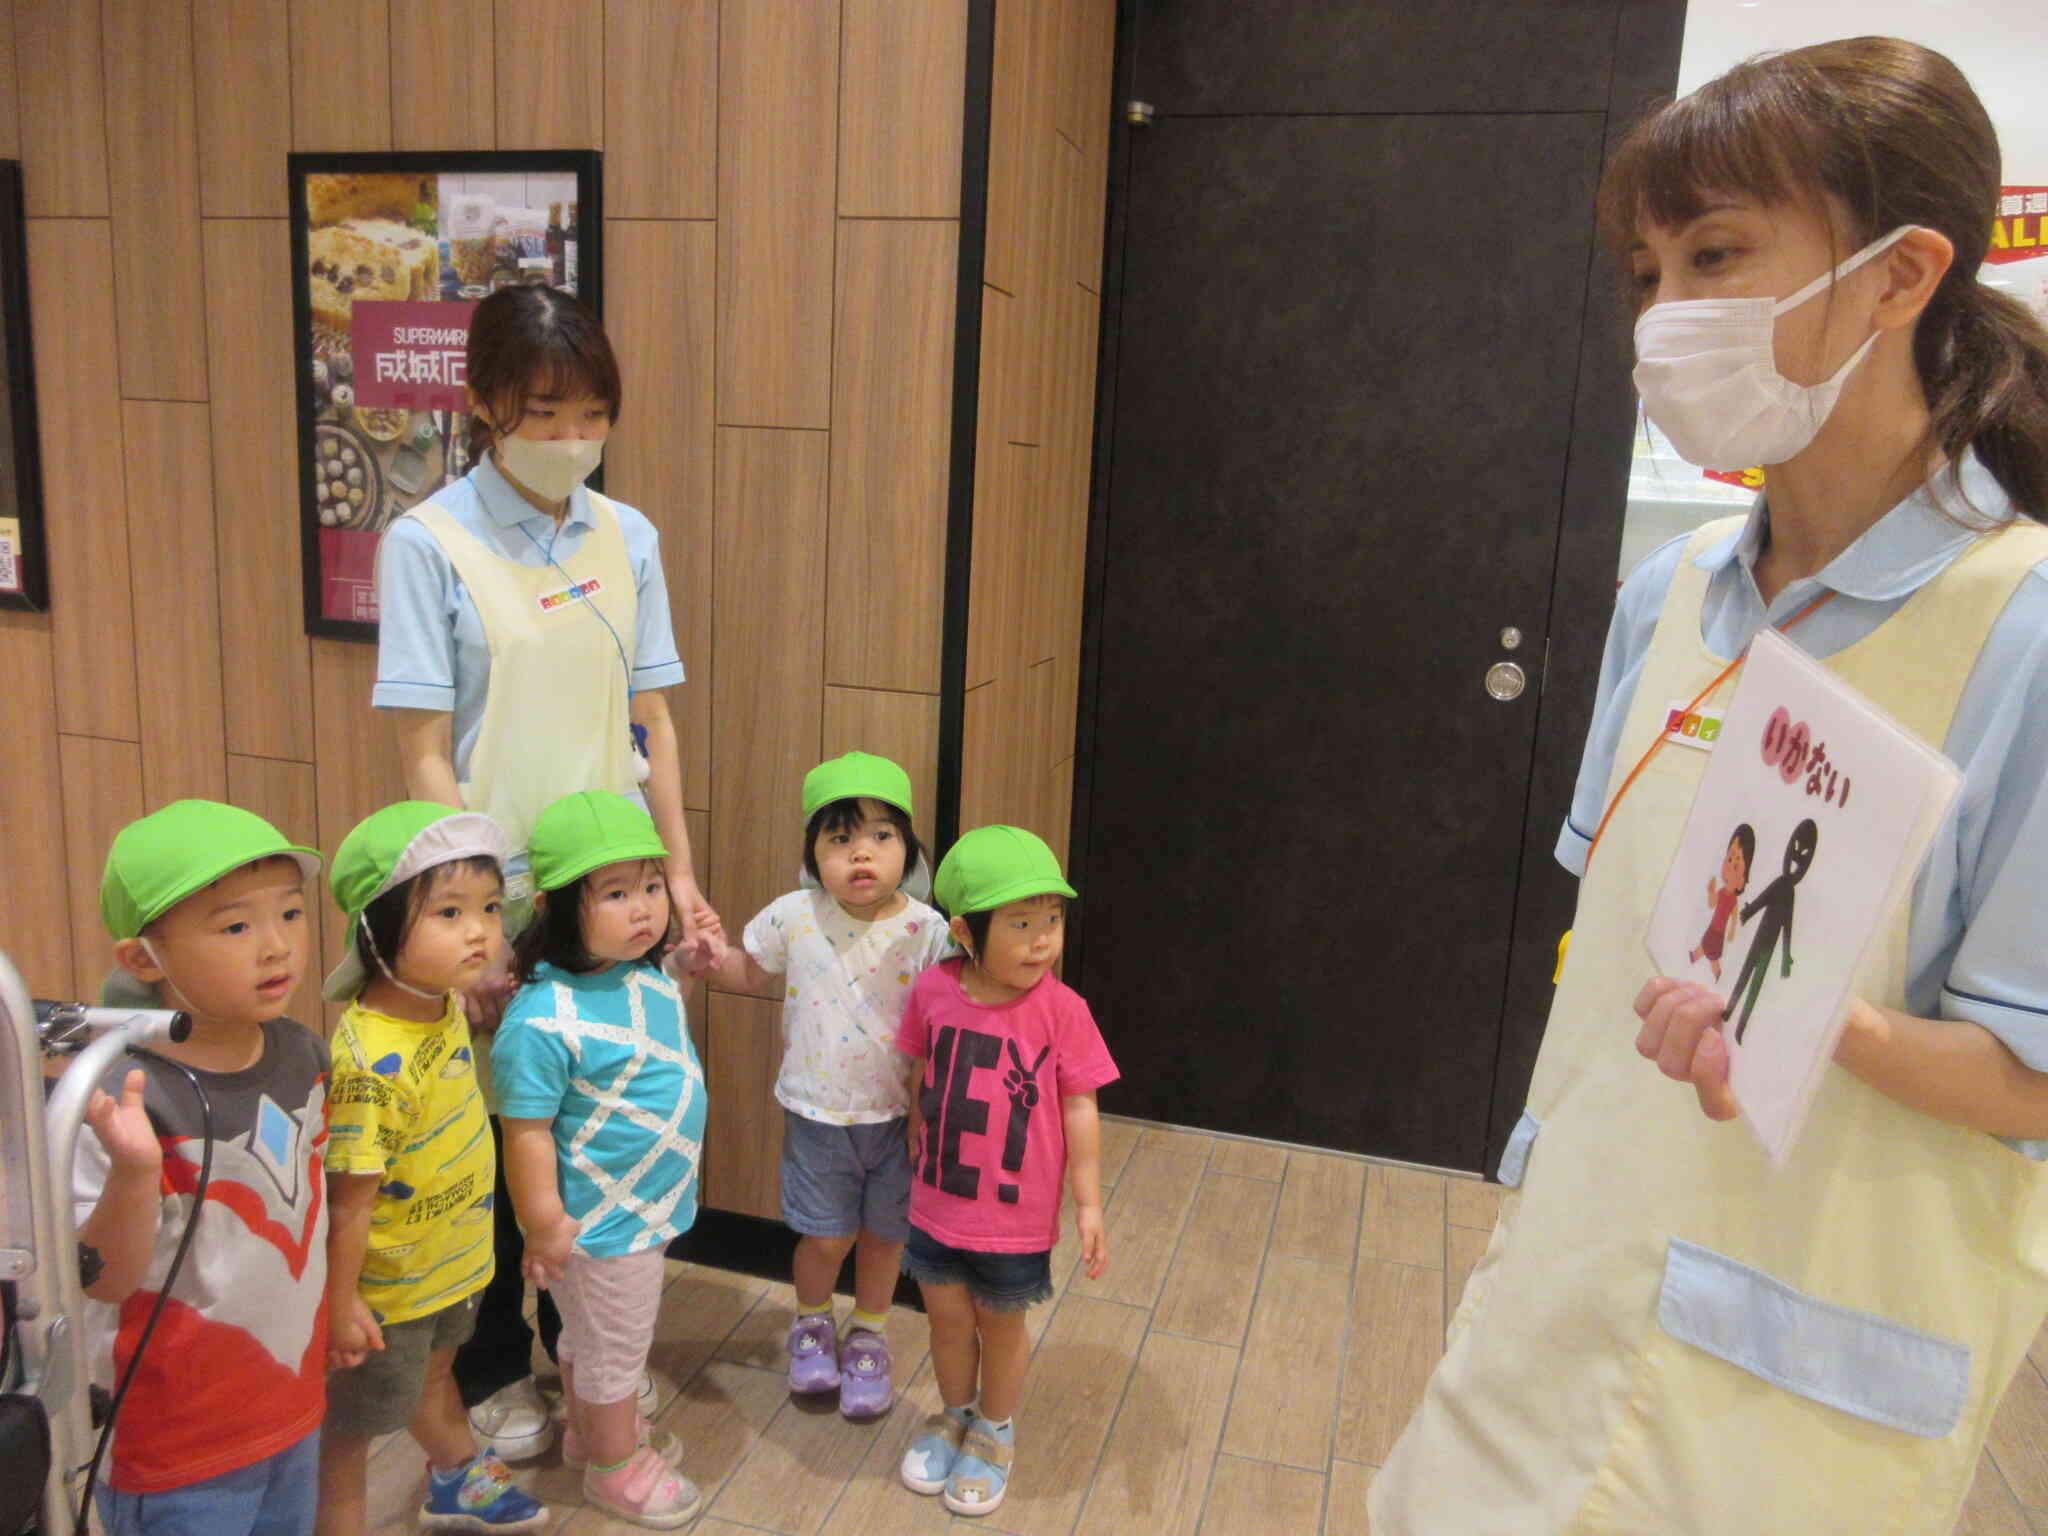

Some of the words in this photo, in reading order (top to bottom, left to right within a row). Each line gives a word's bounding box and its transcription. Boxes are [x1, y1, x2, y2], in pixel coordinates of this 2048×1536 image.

[1987, 216, 2048, 249] AL
[1763, 716, 1850, 808] いかない
